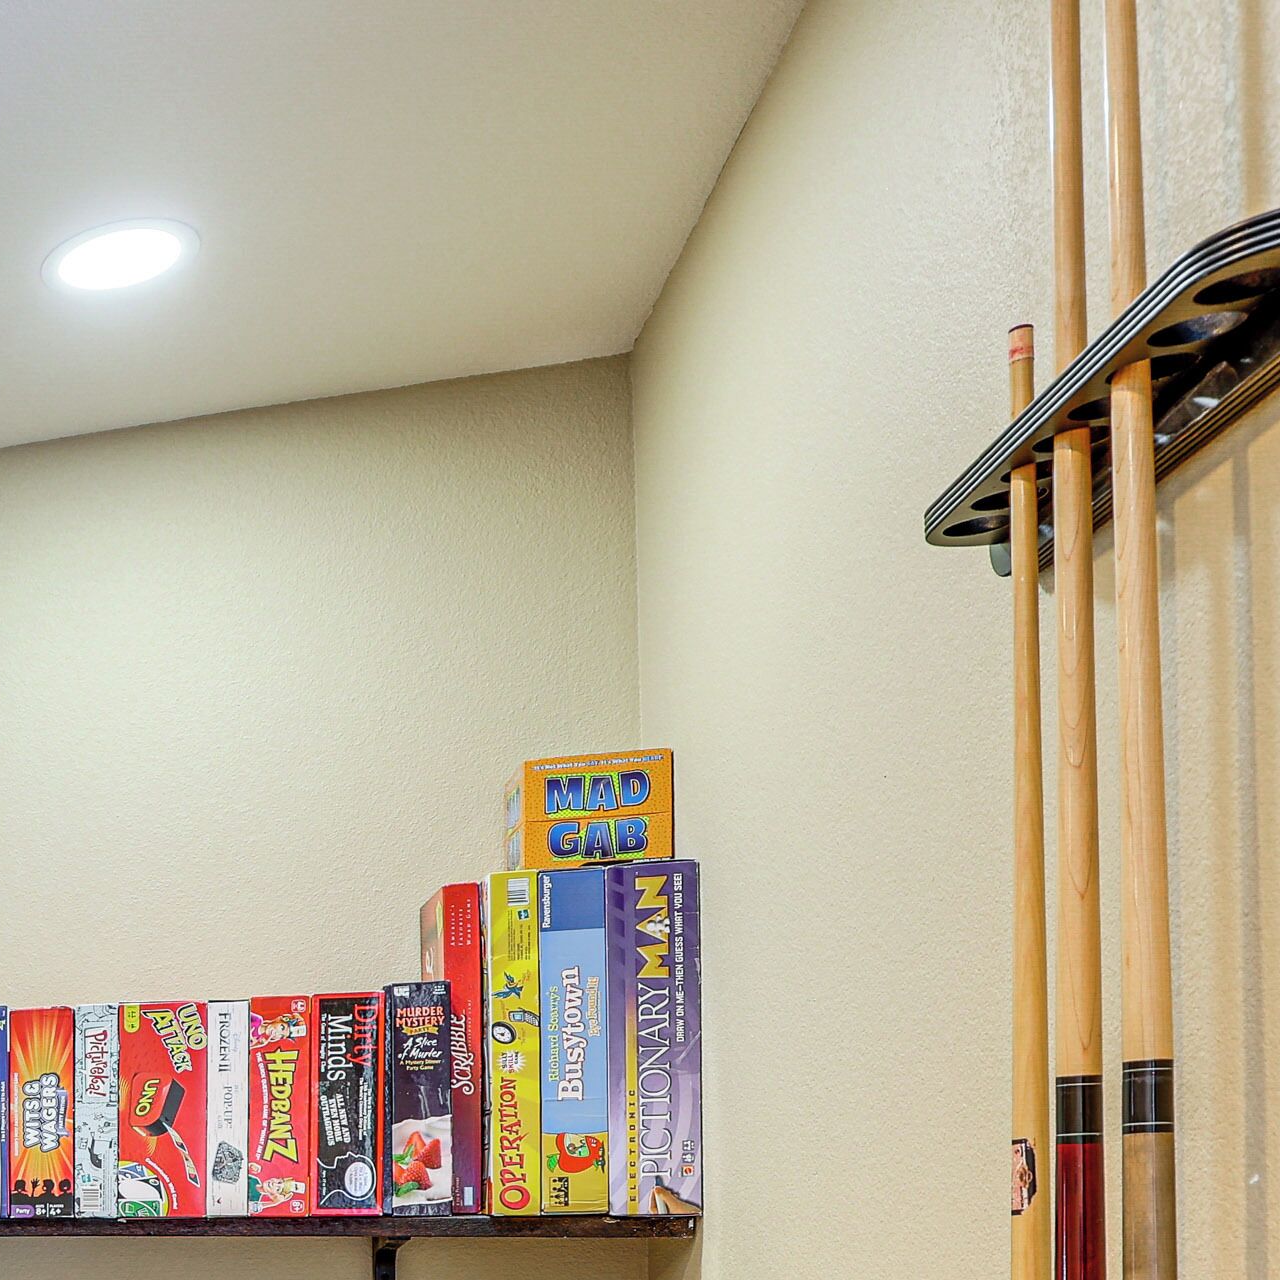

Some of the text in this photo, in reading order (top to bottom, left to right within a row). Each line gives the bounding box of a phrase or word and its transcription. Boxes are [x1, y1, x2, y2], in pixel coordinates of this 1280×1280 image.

[545, 770, 649, 814] MAD
[548, 818, 648, 858] GAB
[542, 874, 553, 929] Ravensburger
[673, 873, 682, 891] SEE!
[674, 893, 683, 909] YOU
[635, 874, 671, 979] MAN
[674, 911, 683, 935] WHAT
[675, 937, 684, 962] GUESS
[177, 1003, 207, 1050] UNO
[395, 1016, 445, 1028] MYSTERY
[397, 1007, 444, 1017] MURDER
[546, 985, 560, 1082] Richard Scarry's
[557, 967, 587, 1101] Busytown
[676, 1005, 684, 1016] ON
[676, 1019, 685, 1042] DRAW
[141, 1010, 192, 1073] ATTACK
[218, 1013, 231, 1072] FROZEN II
[327, 1014, 353, 1081] Minds
[346, 1004, 378, 1067] Dirty
[398, 1048, 407, 1059] of
[402, 1037, 437, 1049] A Slice
[451, 1014, 474, 1095] SCRABBLE
[85, 1029, 109, 1097] Pictureka!
[637, 983, 673, 1179] PICTIONARY
[41, 1074, 59, 1151] WAGERS
[134, 1079, 160, 1116] UNO
[223, 1086, 232, 1124] POP-UP
[262, 1049, 299, 1163] HEDBANZ
[320, 1095, 334, 1146] OUTRAGEOUS
[328, 1098, 342, 1142] EVEN MORE
[336, 1094, 351, 1143] ALL NEW AND
[24, 1099, 40, 1147] WITS
[499, 1077, 530, 1210] OPERATION
